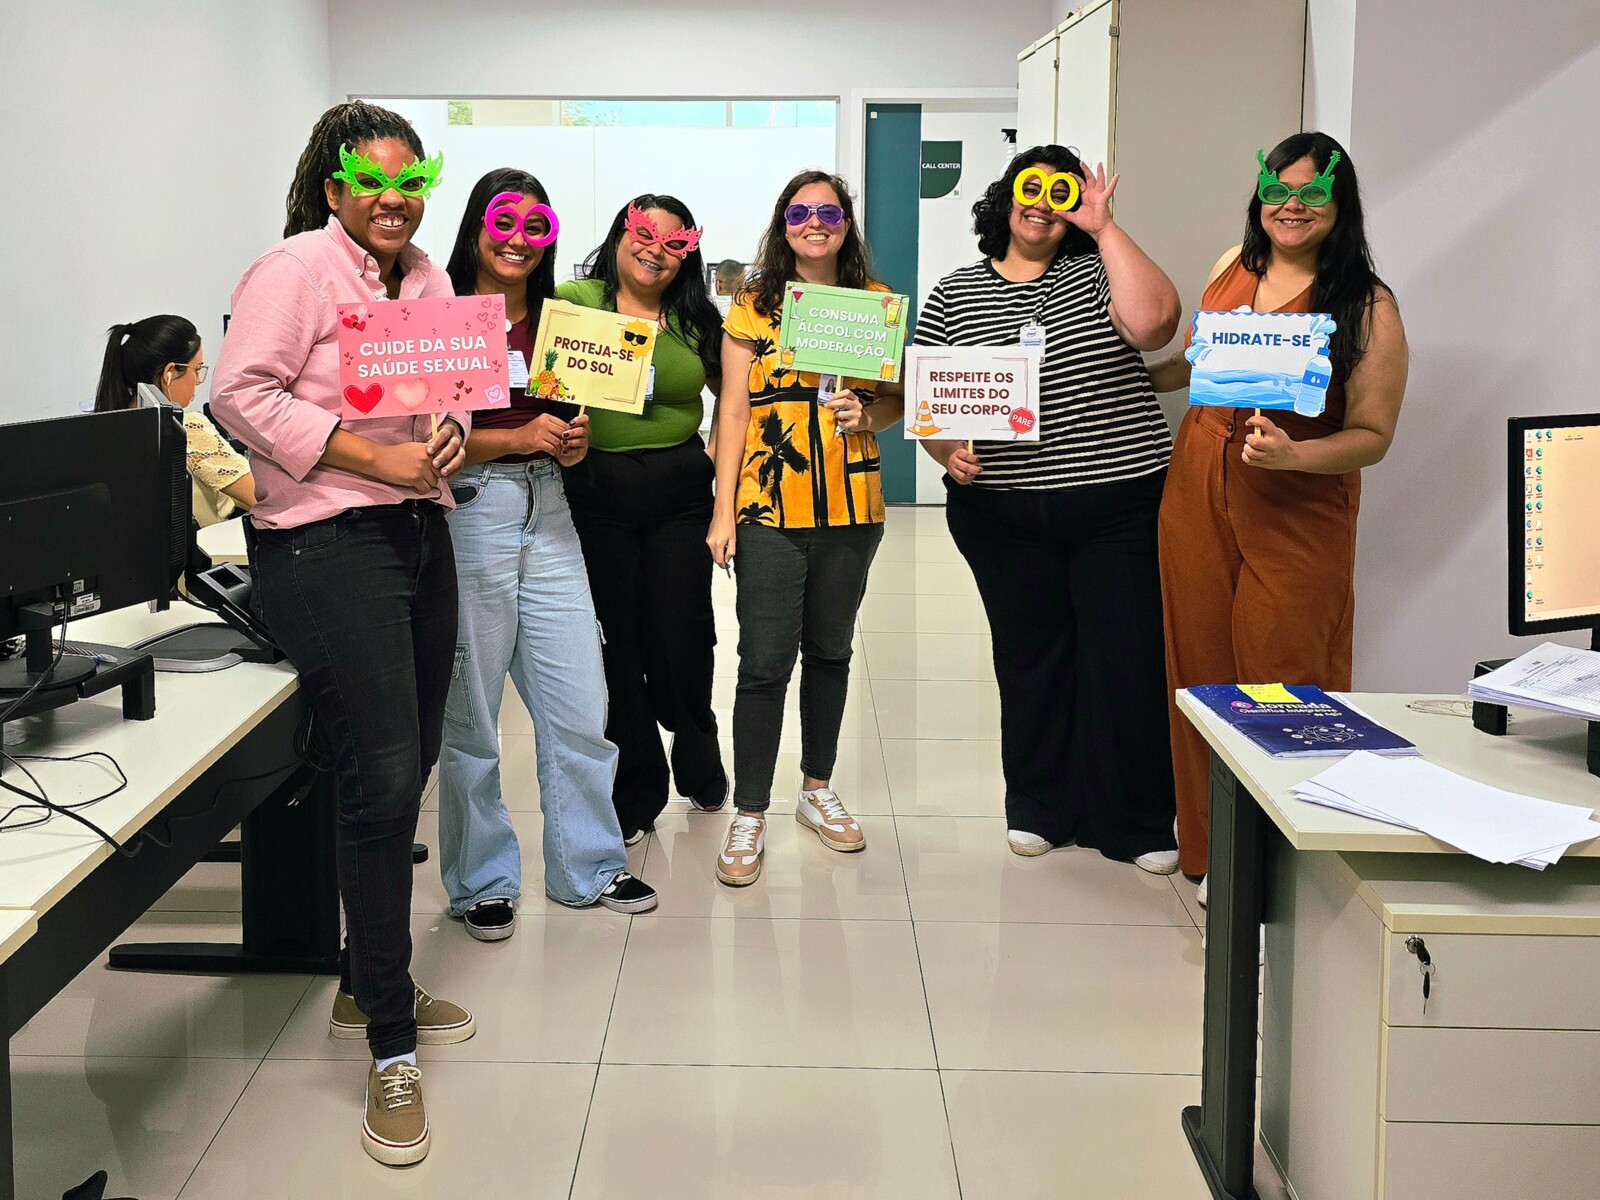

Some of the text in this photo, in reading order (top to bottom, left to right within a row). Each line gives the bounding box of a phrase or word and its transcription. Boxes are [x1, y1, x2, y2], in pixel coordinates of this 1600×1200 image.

[809, 307, 879, 326] CONSUMA
[797, 318, 888, 343] ÁLCOOL COM
[1212, 332, 1311, 347] HIDRATE-SE
[359, 335, 488, 357] CUIDE DA SUA
[554, 336, 634, 362] PROTEJA-SE
[796, 337, 885, 359] MODERAÇÃO
[357, 358, 419, 378] SAÚDE
[423, 356, 491, 373] SEXUAL
[567, 356, 614, 376] DO SOL
[929, 371, 1014, 383] RESPEITE OS
[933, 387, 1010, 400] LIMITES DO
[931, 403, 1012, 416] SEU CORPO
[1011, 414, 1033, 428] PARE
